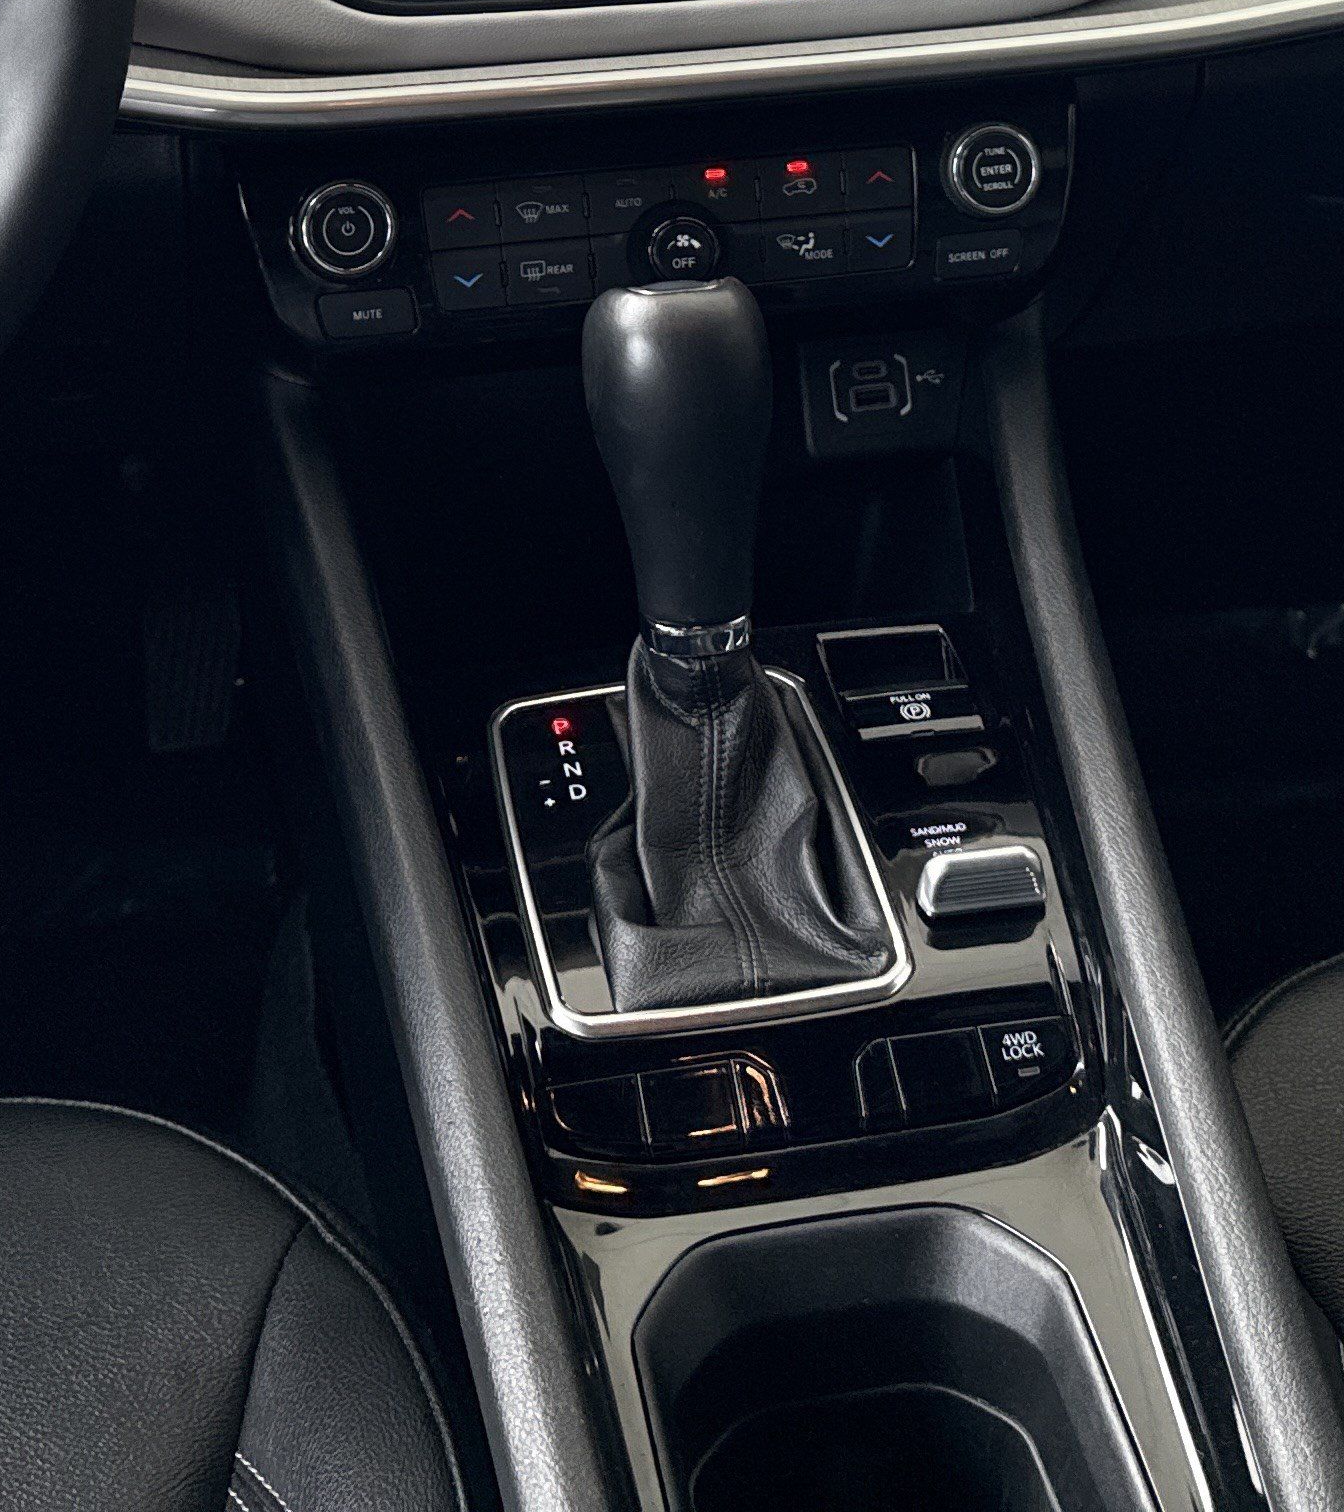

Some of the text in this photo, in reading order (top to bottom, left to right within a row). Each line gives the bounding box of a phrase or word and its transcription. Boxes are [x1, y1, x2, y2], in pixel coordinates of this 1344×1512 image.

[984, 147, 1006, 156] TUNE
[979, 163, 1012, 177] ENTER
[982, 180, 1014, 192] SCROLL
[707, 187, 728, 199] A/C
[545, 203, 570, 214] MAX
[614, 197, 643, 208] AUTO
[337, 206, 356, 215] VOL
[804, 249, 834, 260] MODE
[948, 247, 1009, 263] SCREEN OFF
[546, 263, 574, 275] REAR
[672, 257, 697, 269] OFF
[352, 308, 383, 321] MUTE
[890, 692, 932, 704] PULL ON
[552, 718, 570, 735] P
[558, 740, 576, 756] R
[563, 761, 583, 778] N
[568, 784, 587, 800] D
[924, 835, 962, 849] SNOW
[1002, 1030, 1038, 1046] 4WD
[1001, 1043, 1045, 1061] LOCK
